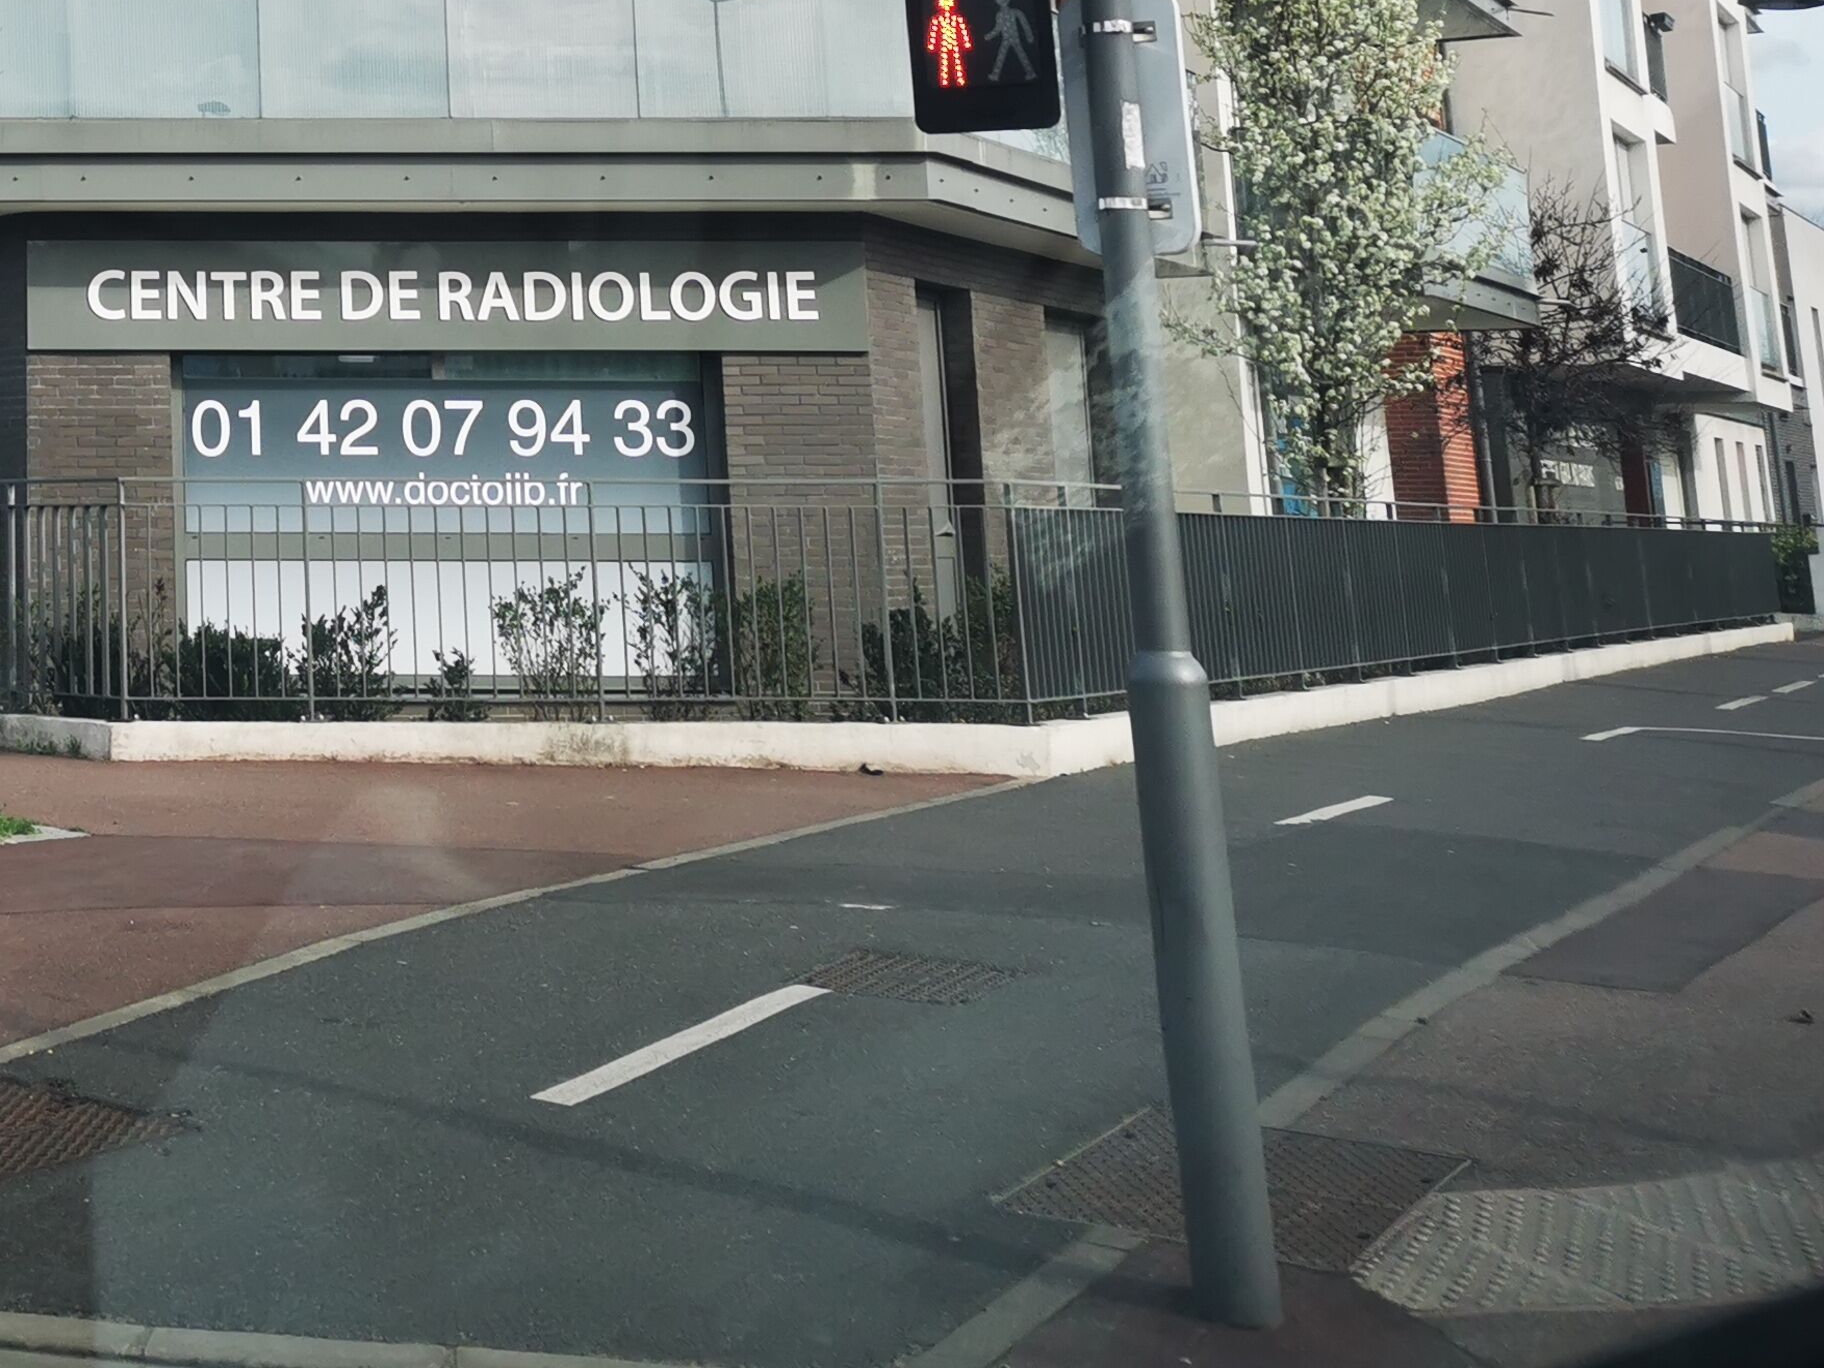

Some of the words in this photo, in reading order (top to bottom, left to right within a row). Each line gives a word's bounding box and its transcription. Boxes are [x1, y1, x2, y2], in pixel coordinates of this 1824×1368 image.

[86, 269, 323, 322] CENTRE
[339, 270, 422, 322] DE
[437, 270, 820, 322] RADIOLOGIE
[191, 399, 262, 458] 01
[296, 399, 379, 458] 42
[401, 399, 484, 458] 07
[508, 399, 591, 458] 94
[613, 399, 696, 458] 33
